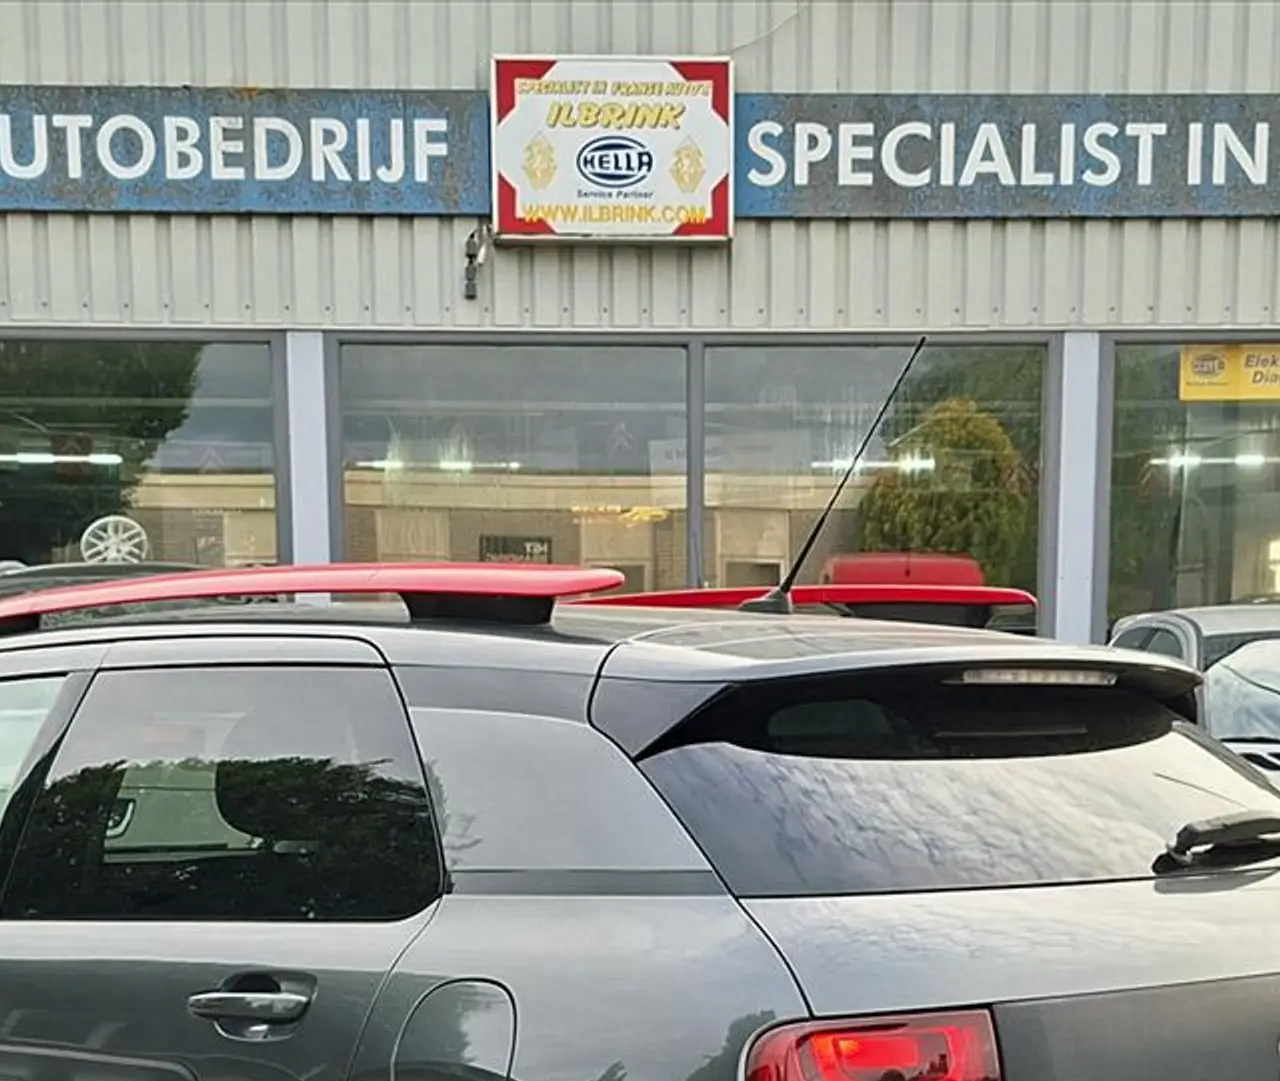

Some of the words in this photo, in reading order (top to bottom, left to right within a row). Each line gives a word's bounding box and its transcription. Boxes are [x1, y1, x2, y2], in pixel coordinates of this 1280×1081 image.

[546, 101, 686, 129] ILBRINK
[580, 150, 654, 173] HELLA
[746, 121, 1167, 187] SPECIALIST
[1187, 122, 1270, 186] IN
[522, 205, 707, 223] WWW.ILBRINK.COM
